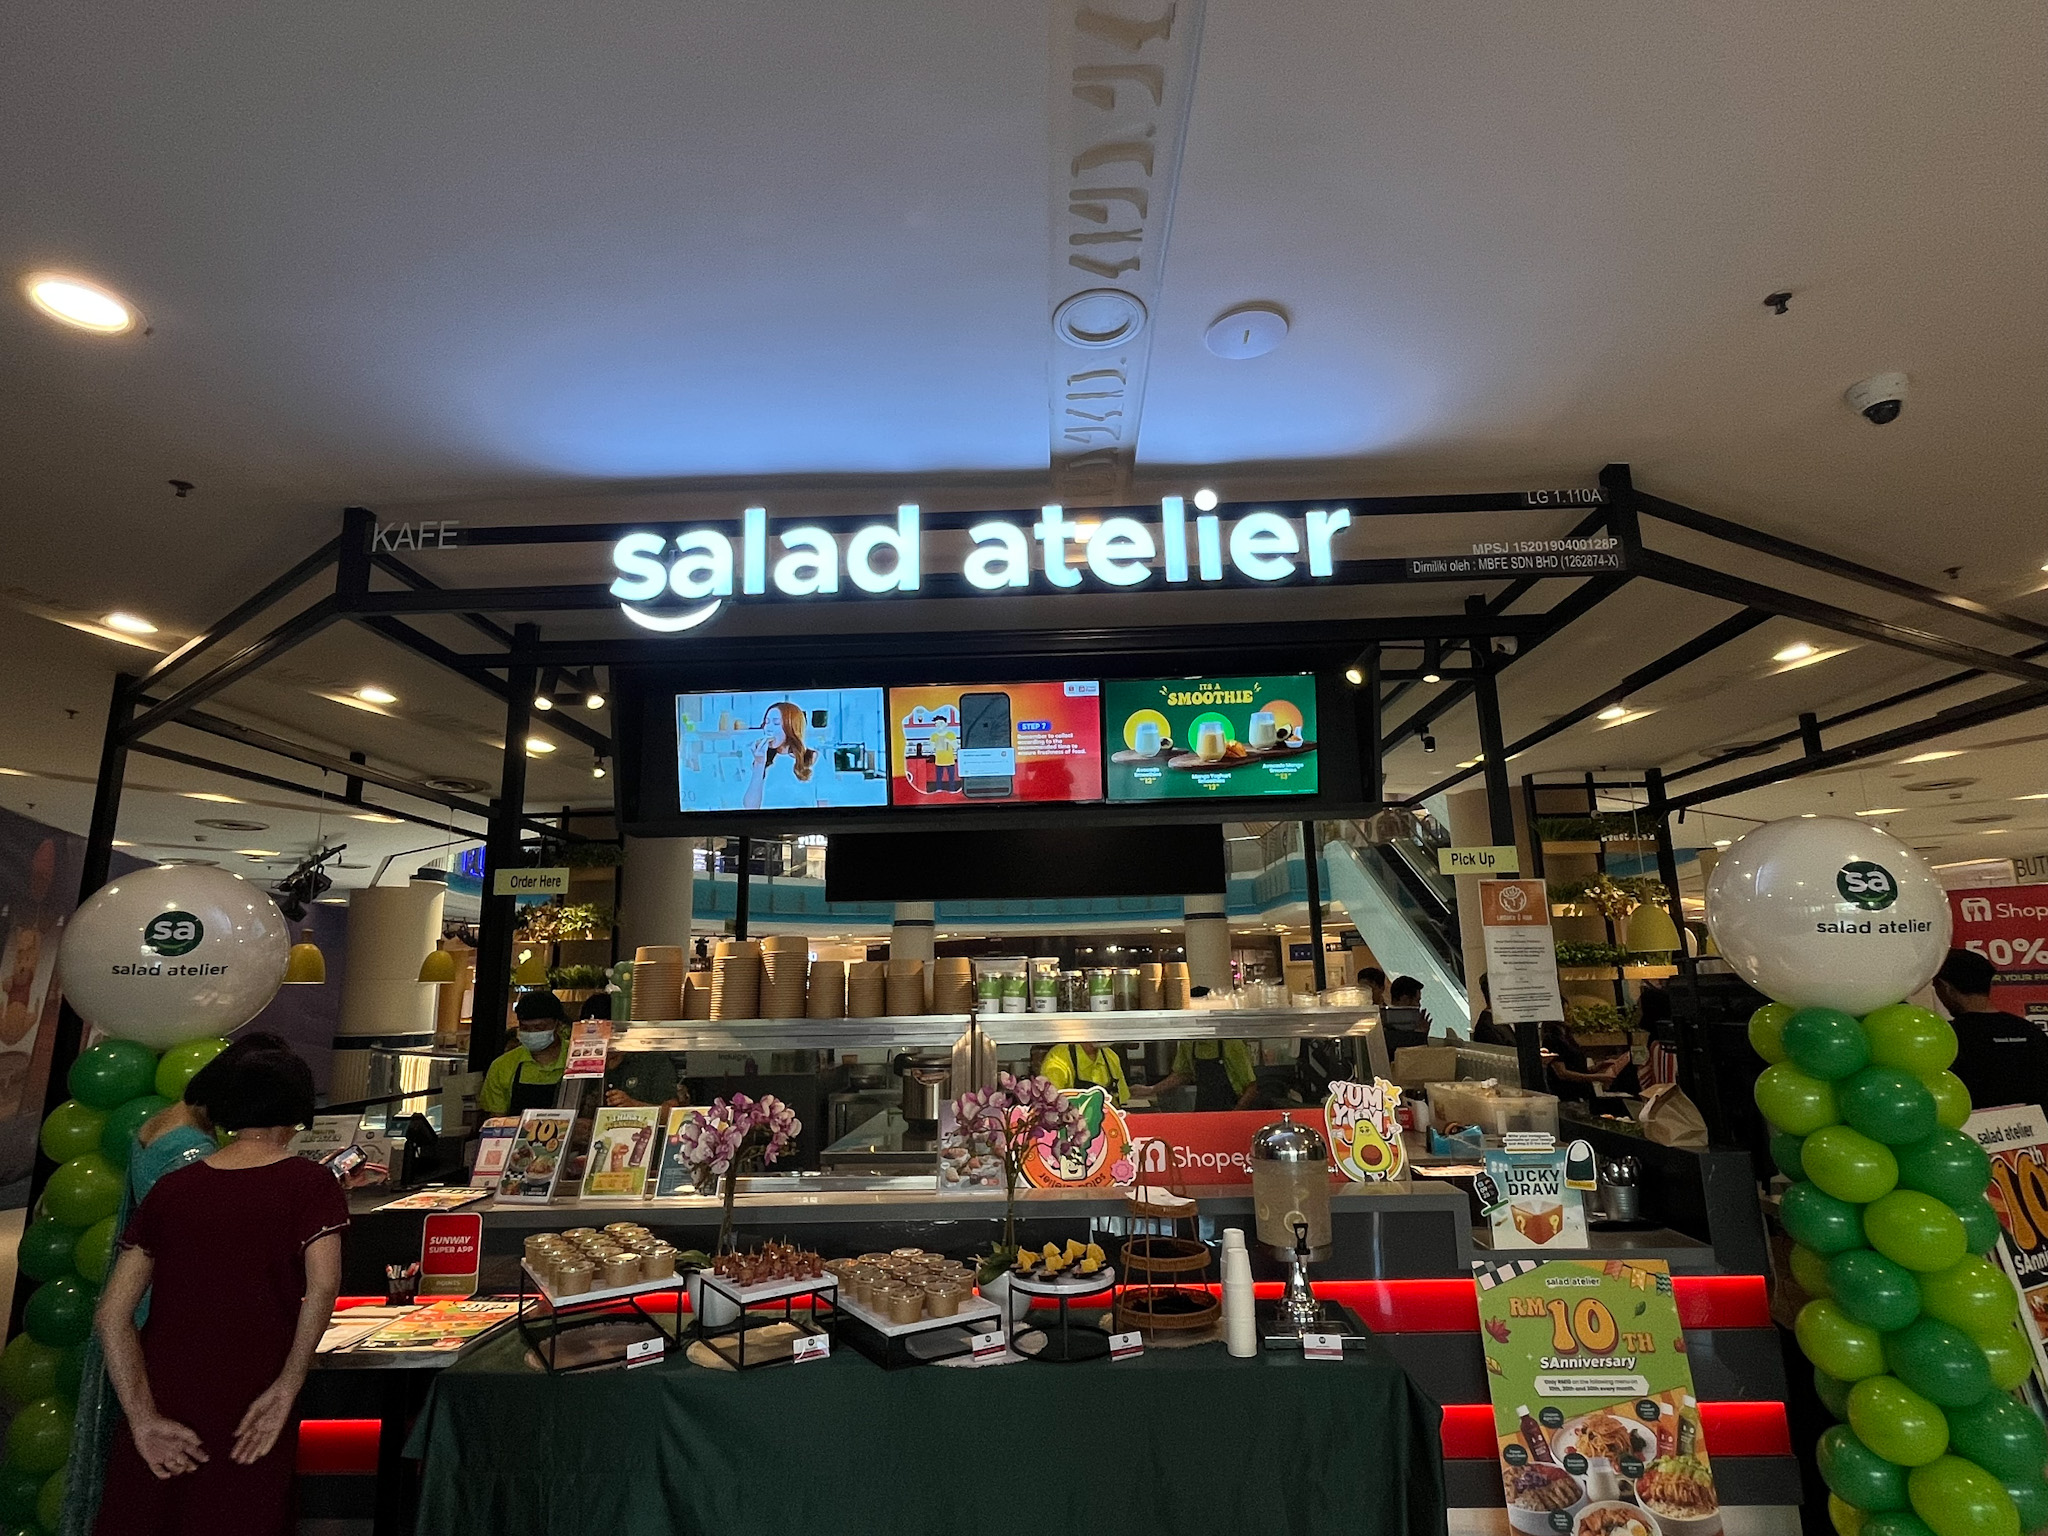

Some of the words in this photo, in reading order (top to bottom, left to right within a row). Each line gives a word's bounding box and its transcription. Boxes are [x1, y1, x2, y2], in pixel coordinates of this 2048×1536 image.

[1527, 490, 1549, 505] LG
[1554, 488, 1602, 503] 1.110A
[371, 520, 459, 552] KAFE
[609, 504, 920, 600] salad
[963, 489, 1351, 589] atelier
[1472, 542, 1509, 555] MPSJ
[1514, 538, 1618, 553] 1520190400128P
[1413, 560, 1448, 573] Dimiliki
[1449, 559, 1471, 572] oleh
[1479, 557, 1508, 570] MBFE
[1511, 556, 1534, 569] SDN
[1536, 555, 1558, 569] BHD
[1561, 553, 1619, 570] (1262874-X)
[1167, 690, 1254, 706] SMOOTHIE
[1451, 852, 1476, 865] Pick
[1479, 852, 1495, 867] Up
[510, 875, 537, 888] Order
[539, 875, 561, 887] Here
[1845, 870, 1890, 893] sa
[152, 921, 196, 940] sa
[1816, 920, 1871, 934] salad
[1878, 919, 1932, 934] atelier
[111, 963, 161, 976] salad
[167, 964, 229, 976] atelier
[2004, 973, 2033, 981] YOUR
[1331, 1082, 1383, 1110] YUM
[1978, 1126, 2004, 1145] salad
[2004, 1122, 2034, 1140] atelier
[1505, 1169, 1560, 1182] LUCKY
[1508, 1183, 1559, 1196] DRAW
[430, 1236, 471, 1245] SUNWAY
[429, 1246, 455, 1254] SUPER
[1546, 1277, 1570, 1286] salad
[1572, 1277, 1600, 1286] atelier
[1509, 1296, 1547, 1317] RM
[1547, 1297, 1619, 1354] 10
[1622, 1332, 1656, 1353] TH
[1540, 1355, 1637, 1371] SAnniversary
